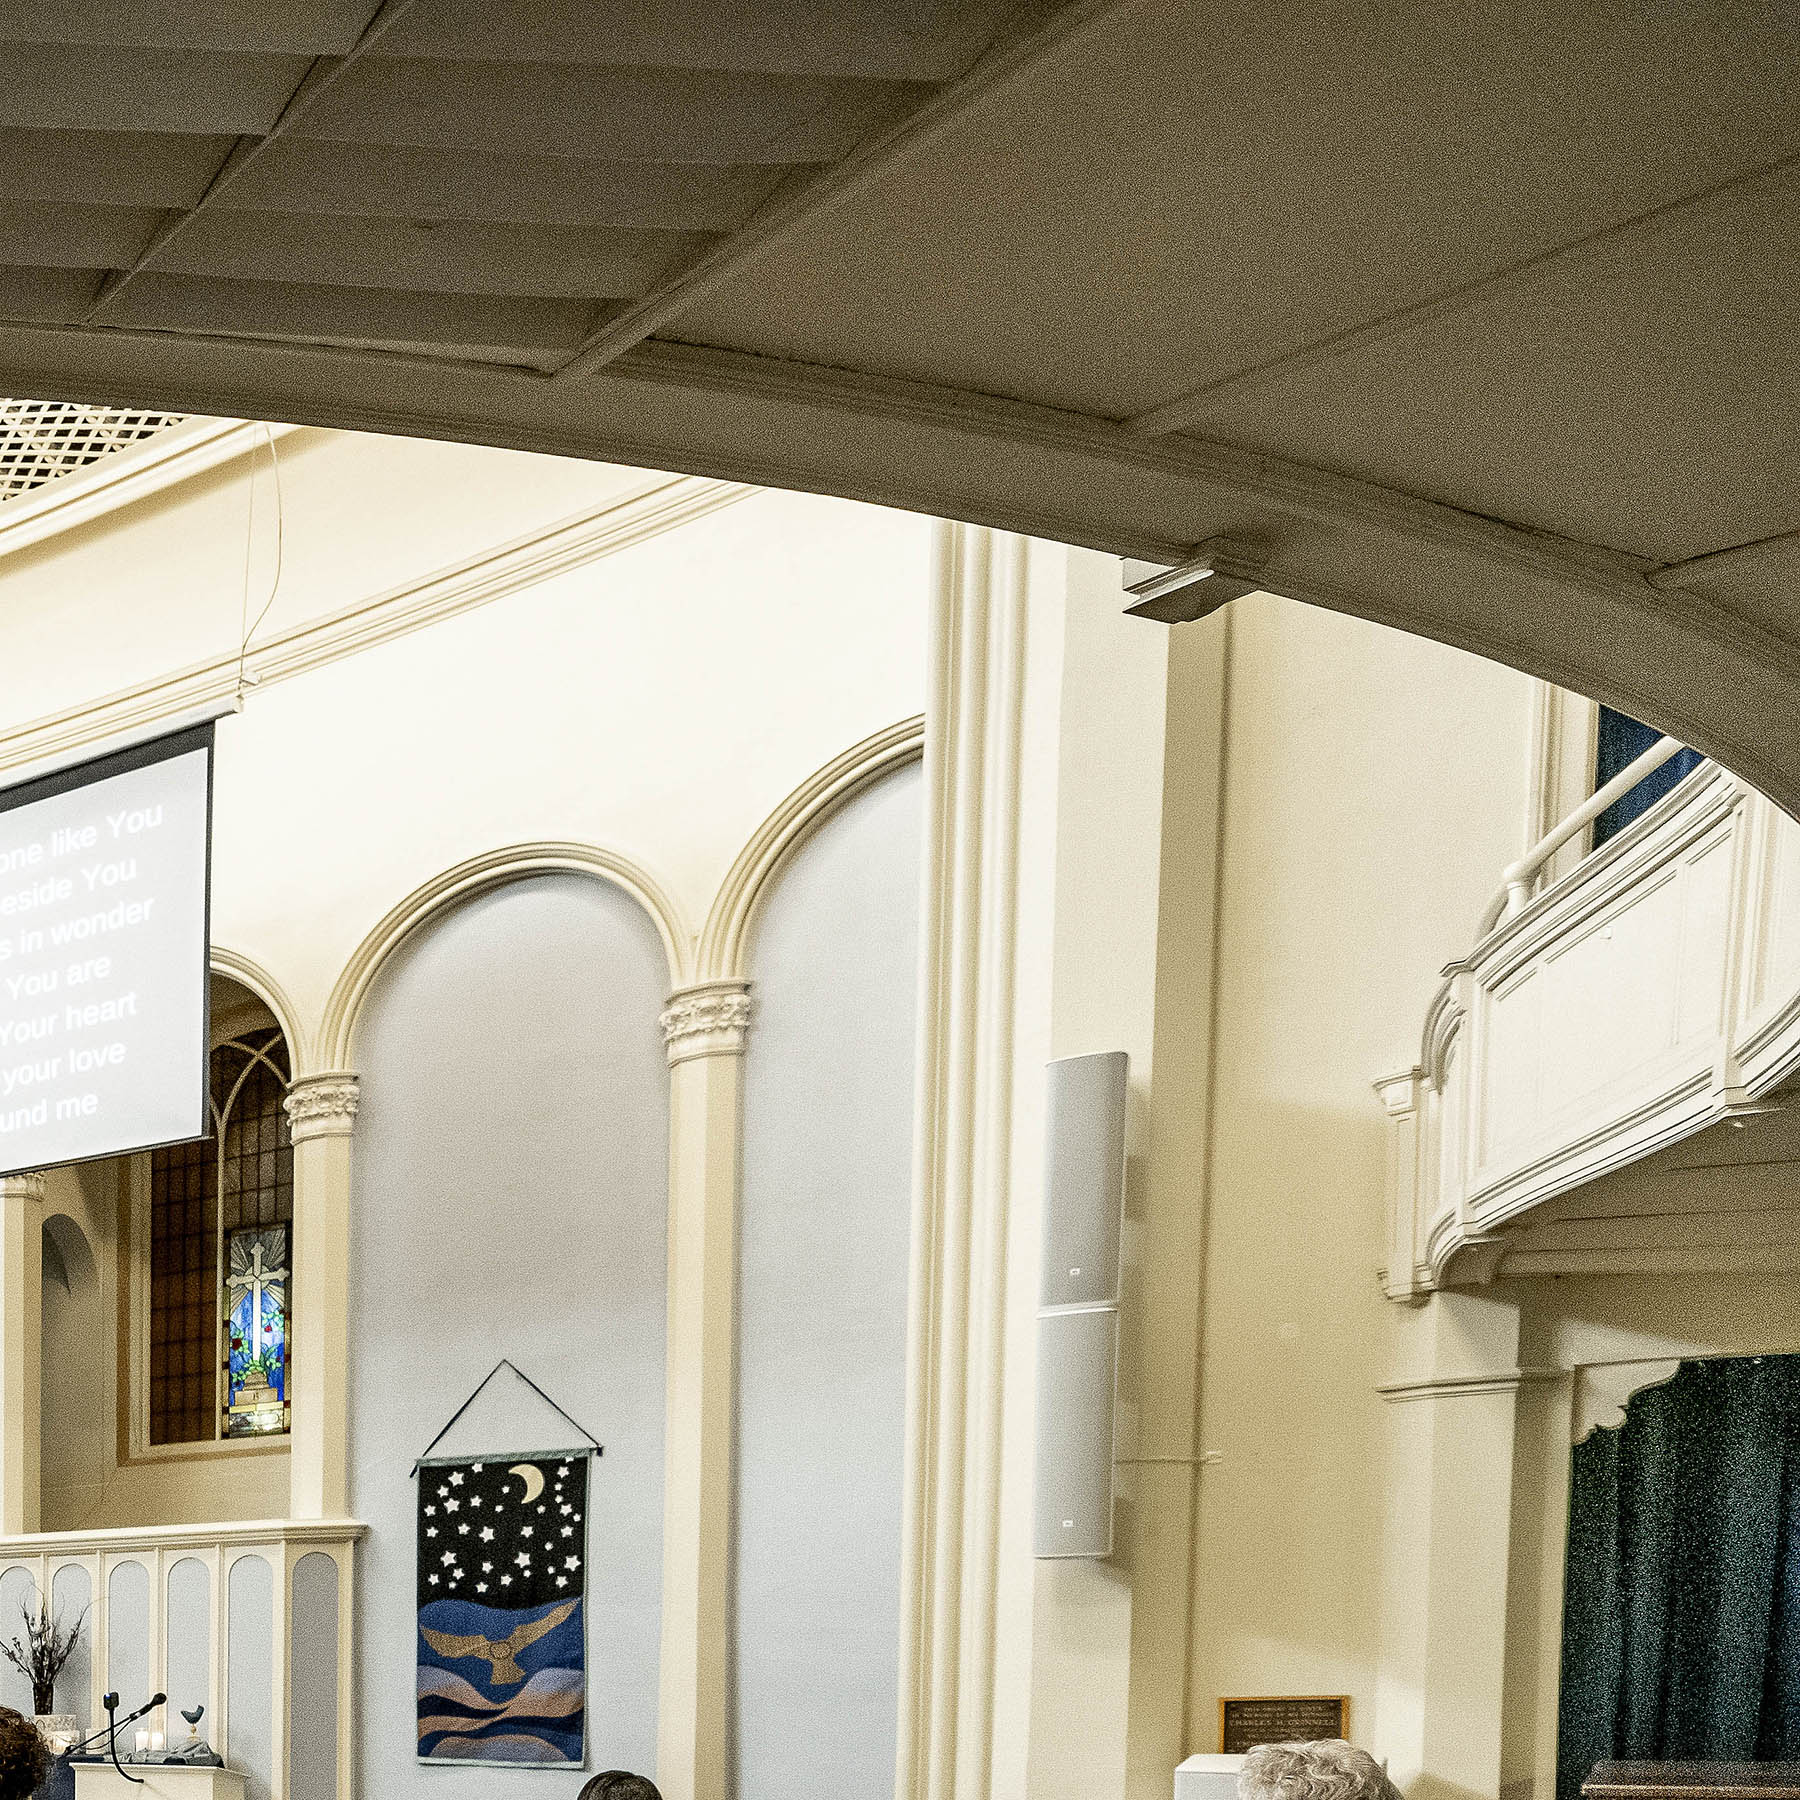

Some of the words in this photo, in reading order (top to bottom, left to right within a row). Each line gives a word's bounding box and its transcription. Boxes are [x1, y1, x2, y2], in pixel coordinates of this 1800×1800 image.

[51, 826, 98, 857] like
[106, 804, 163, 838] You
[80, 858, 138, 891] You
[20, 929, 43, 954] in
[50, 897, 155, 945] wonder
[5, 970, 58, 1000] You
[66, 956, 112, 986] are
[66, 991, 139, 1030] heart
[2, 1057, 62, 1096] your
[69, 1042, 128, 1074] love
[56, 1093, 98, 1120] me
